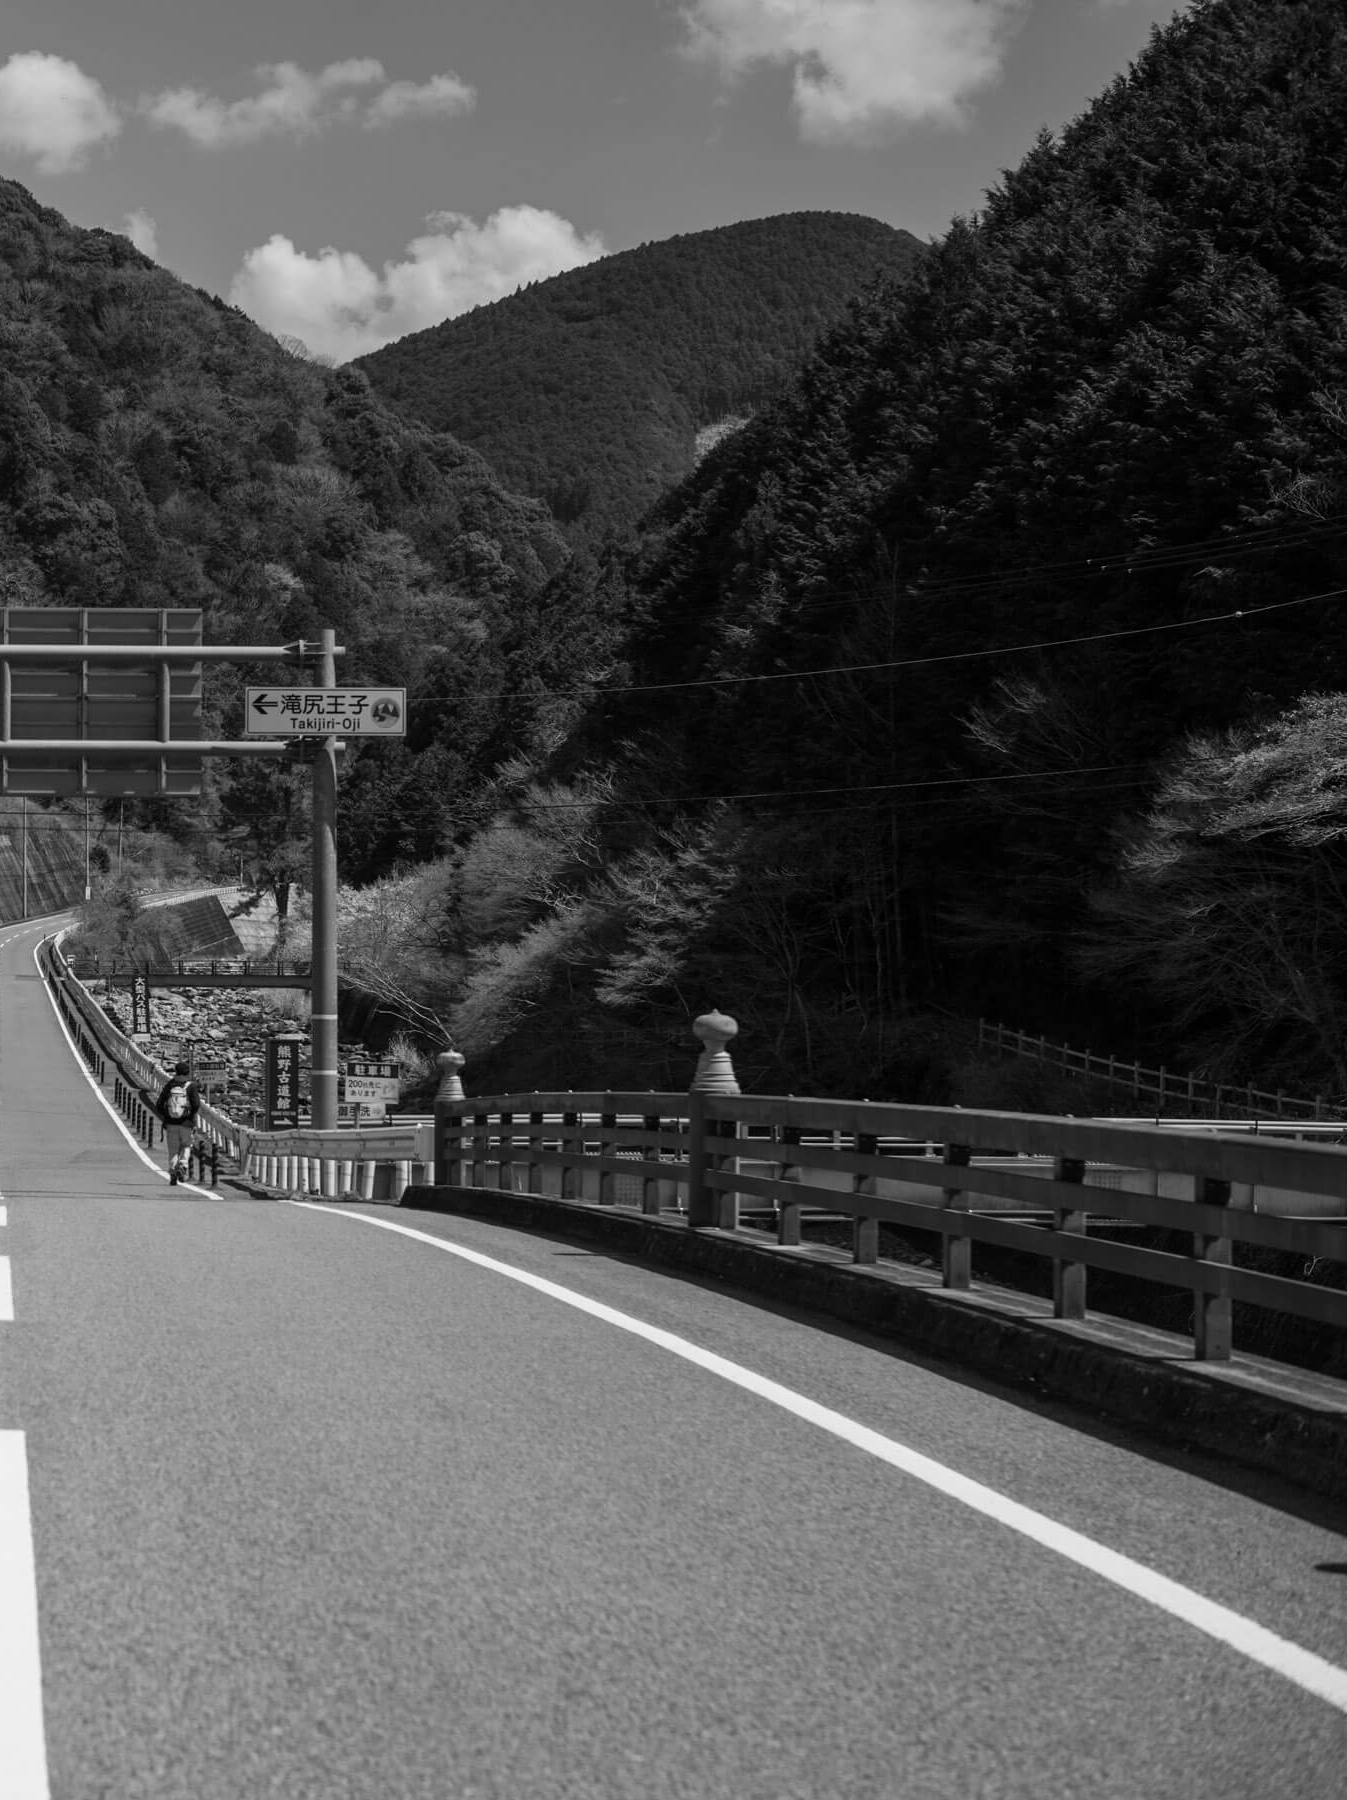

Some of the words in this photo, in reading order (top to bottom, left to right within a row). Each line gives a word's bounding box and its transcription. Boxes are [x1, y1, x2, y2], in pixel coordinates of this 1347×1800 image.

[280, 694, 369, 715] 滝尻王子
[290, 718, 361, 731] Takijiri-Oji
[276, 1045, 292, 1110] 熊野古道館
[354, 1064, 391, 1077] 駐車場
